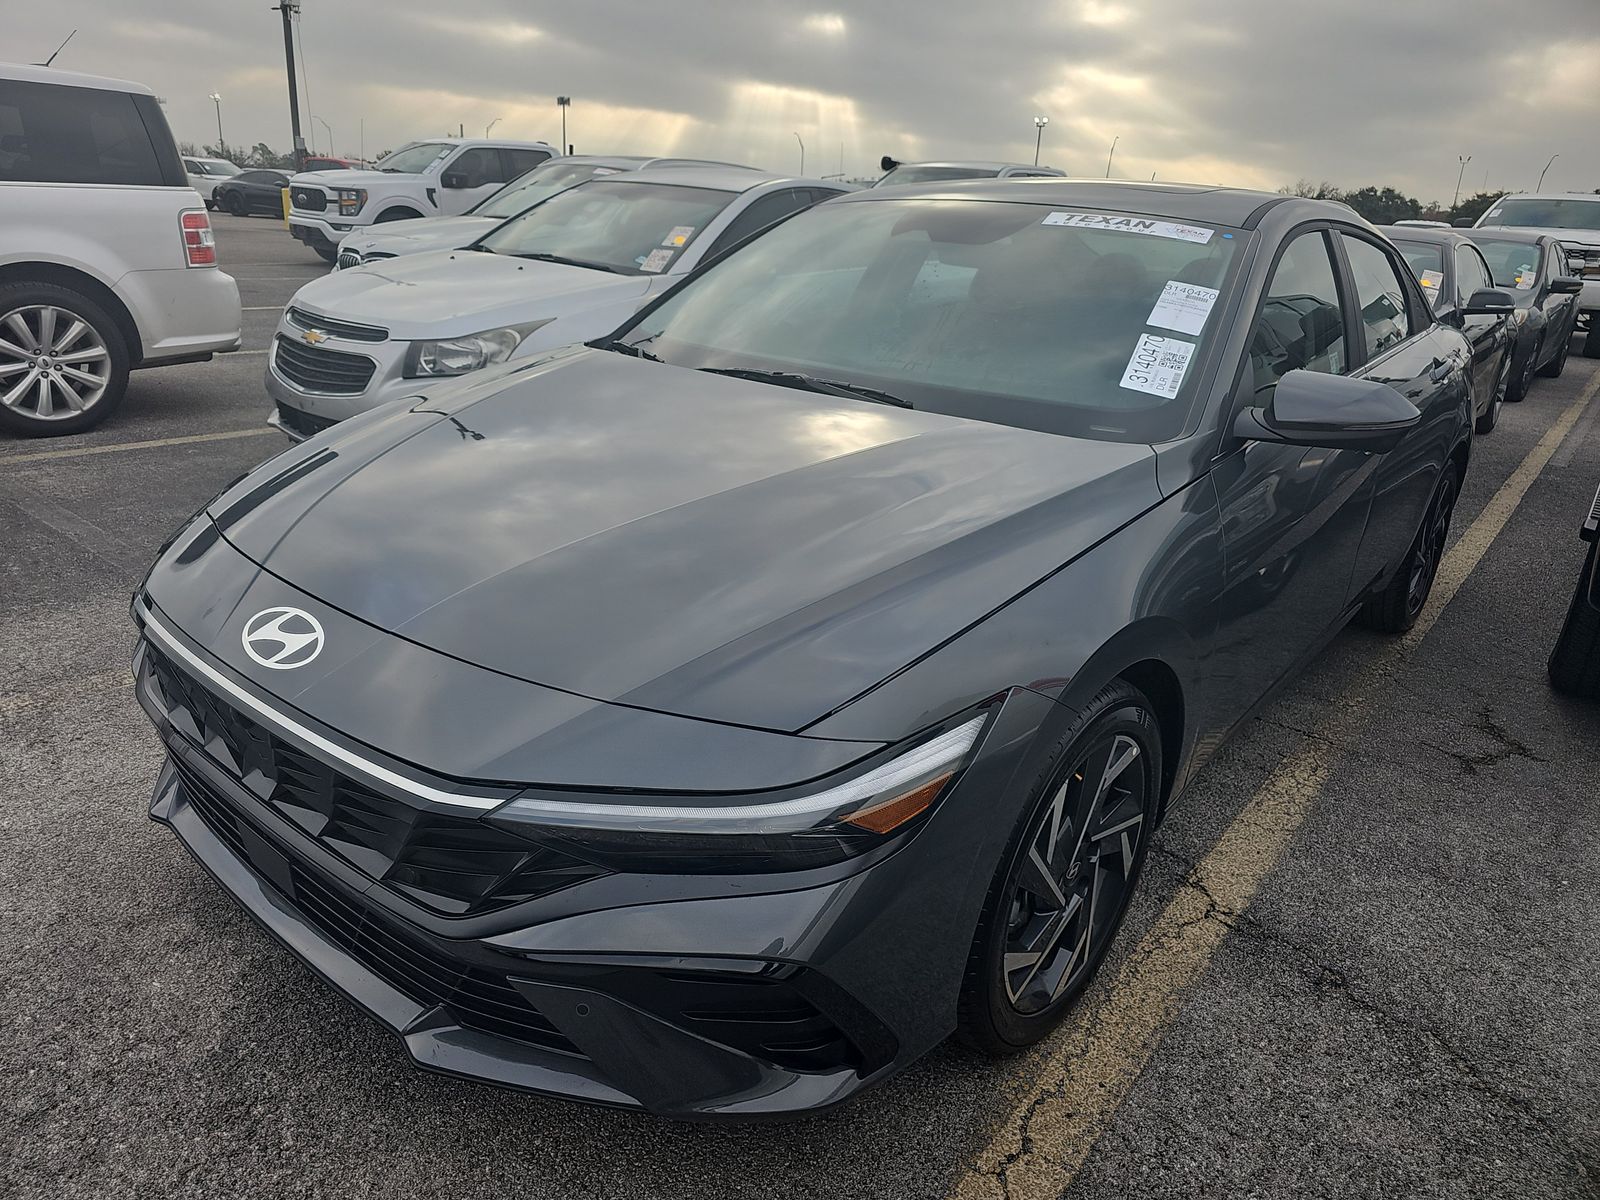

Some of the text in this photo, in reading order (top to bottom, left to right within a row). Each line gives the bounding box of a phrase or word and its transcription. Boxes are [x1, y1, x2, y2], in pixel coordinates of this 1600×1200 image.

[1066, 213, 1156, 229] TEXAN
[1165, 284, 1216, 300] 3140470
[1129, 334, 1165, 384] 3140470
[1155, 376, 1168, 391] DLR
